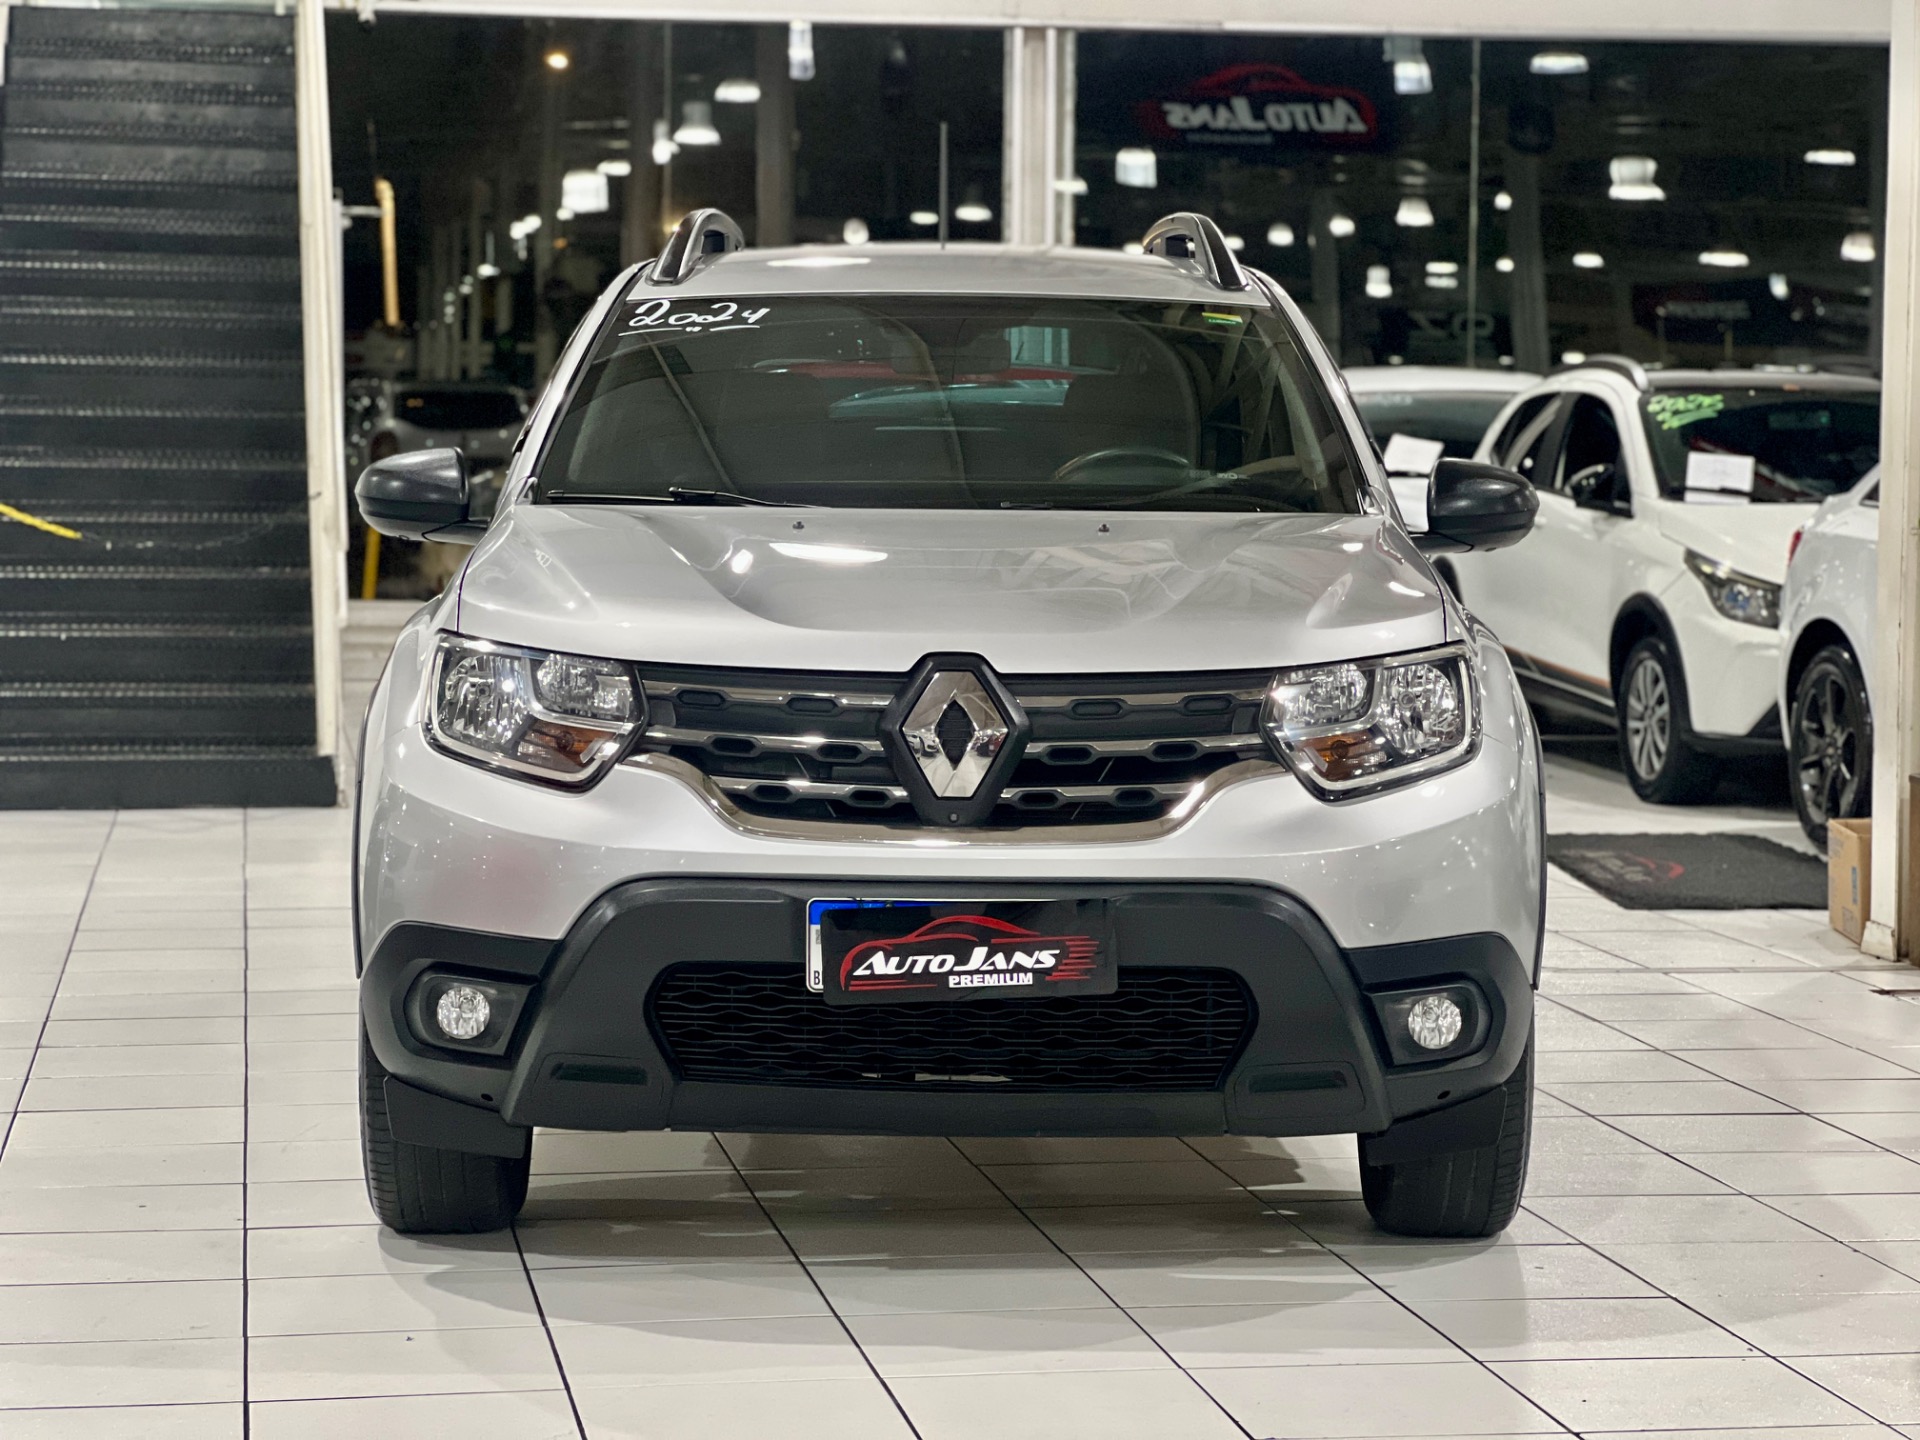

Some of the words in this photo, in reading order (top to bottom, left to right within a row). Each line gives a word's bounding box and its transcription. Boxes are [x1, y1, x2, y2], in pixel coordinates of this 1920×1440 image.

[628, 299, 771, 328] 2024
[853, 950, 955, 976] AUTO
[953, 946, 1060, 972] JANS
[948, 972, 1033, 988] PREMIUM
